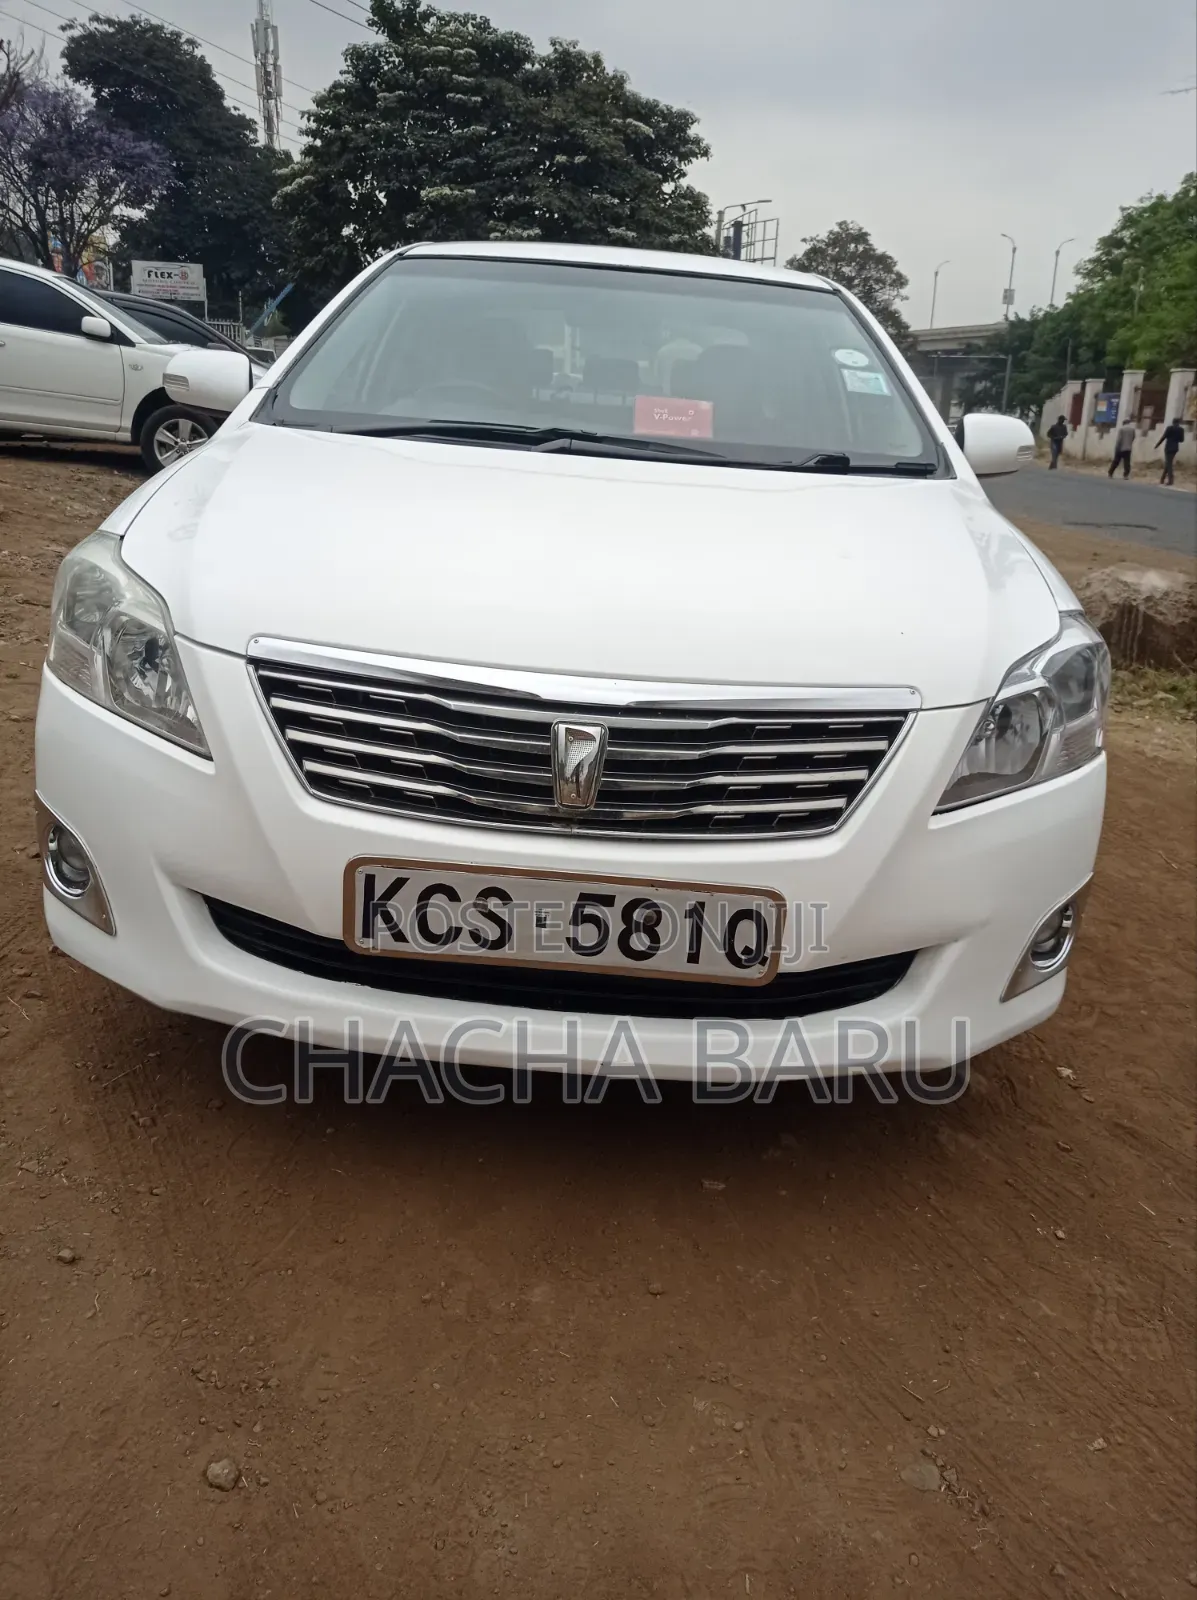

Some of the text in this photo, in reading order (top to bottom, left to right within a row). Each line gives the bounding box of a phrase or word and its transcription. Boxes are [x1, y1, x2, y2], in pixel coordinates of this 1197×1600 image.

[653, 413, 692, 421] V-Power
[362, 873, 769, 969] KCS 581Q
